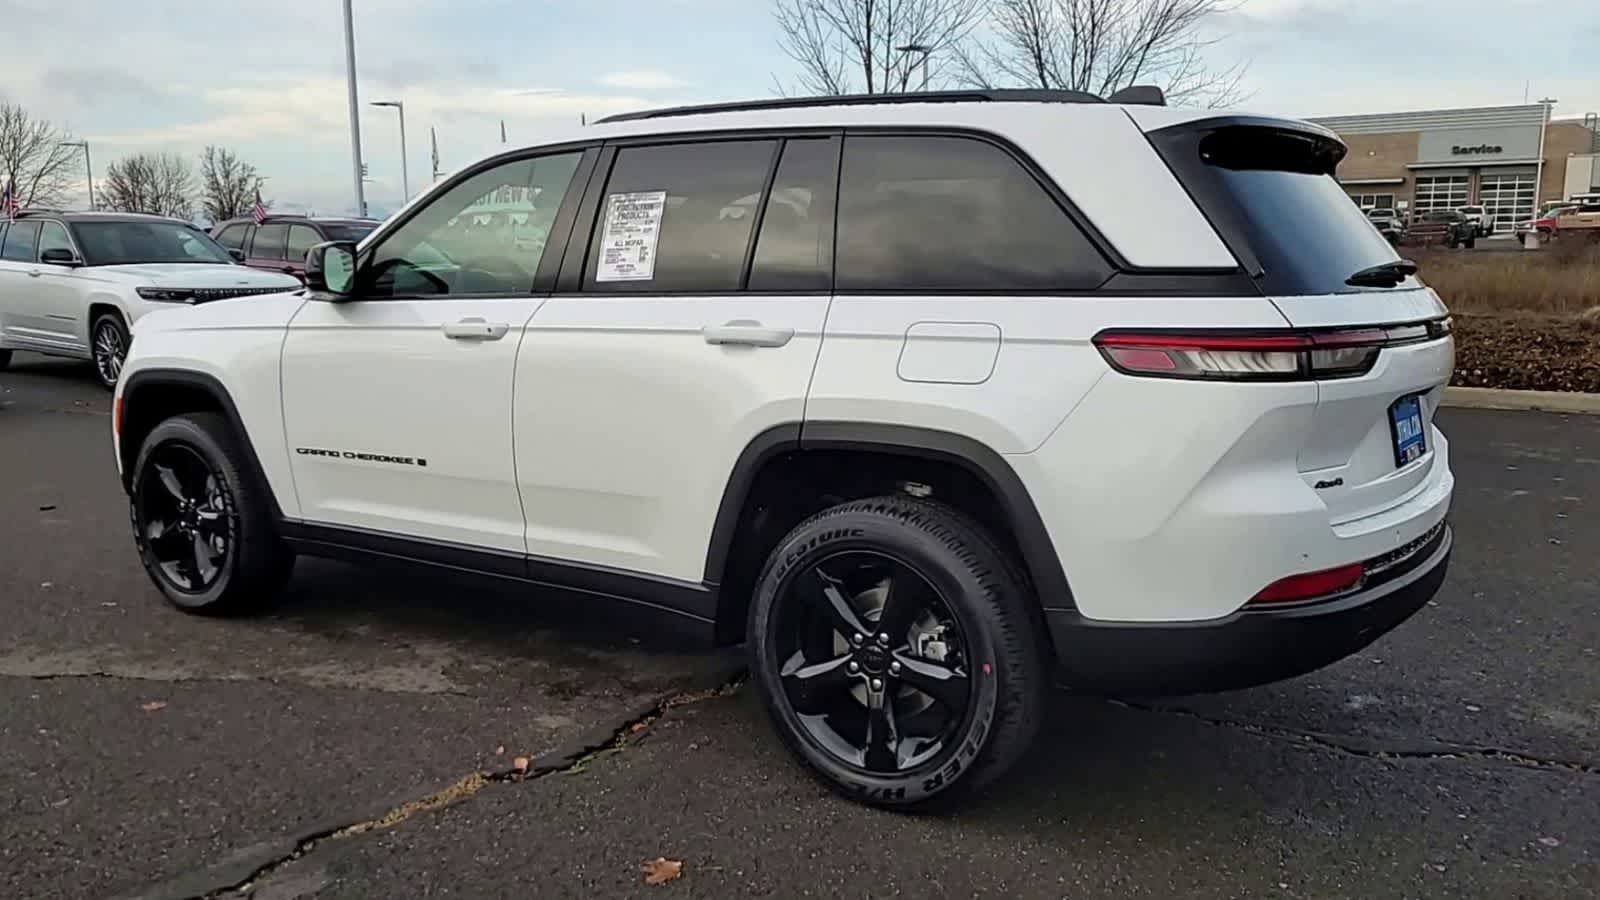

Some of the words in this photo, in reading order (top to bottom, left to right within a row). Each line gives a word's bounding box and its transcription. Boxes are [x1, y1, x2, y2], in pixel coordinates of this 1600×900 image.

[1452, 143, 1503, 156] Service
[296, 448, 340, 458] GRAND
[343, 452, 414, 465] CHEROKEE
